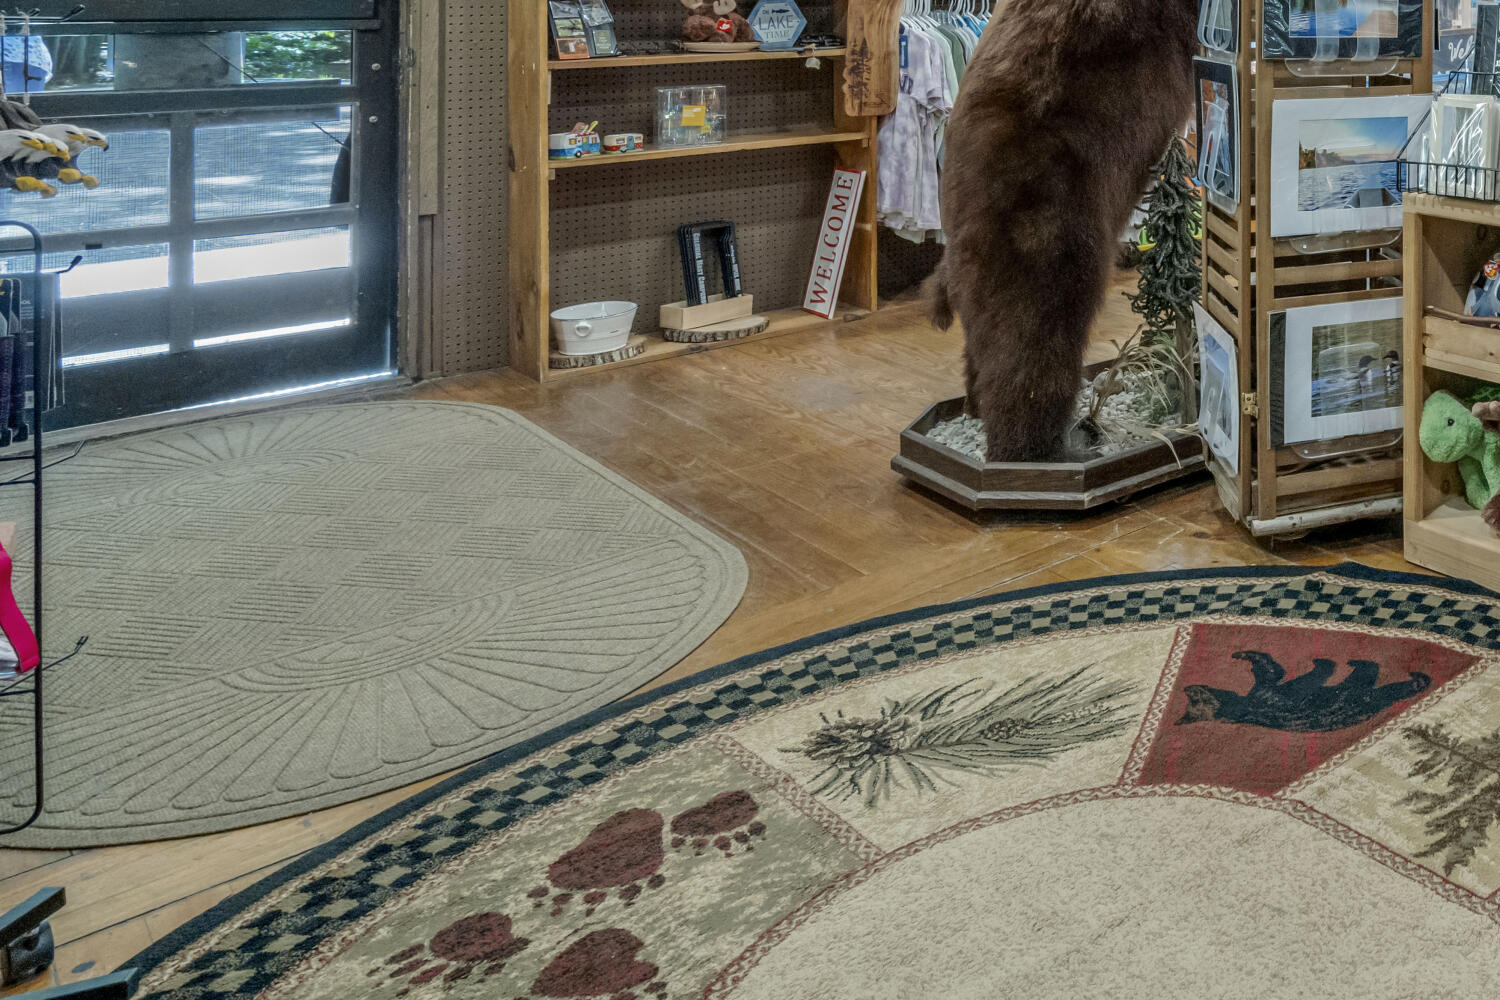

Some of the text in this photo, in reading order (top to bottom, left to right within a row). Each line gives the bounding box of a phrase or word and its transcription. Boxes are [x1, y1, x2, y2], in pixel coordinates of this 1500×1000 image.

[758, 14, 795, 31] LAKE
[763, 30, 790, 40] TIME
[1448, 34, 1475, 62] Wel
[810, 176, 854, 305] WELCOME
